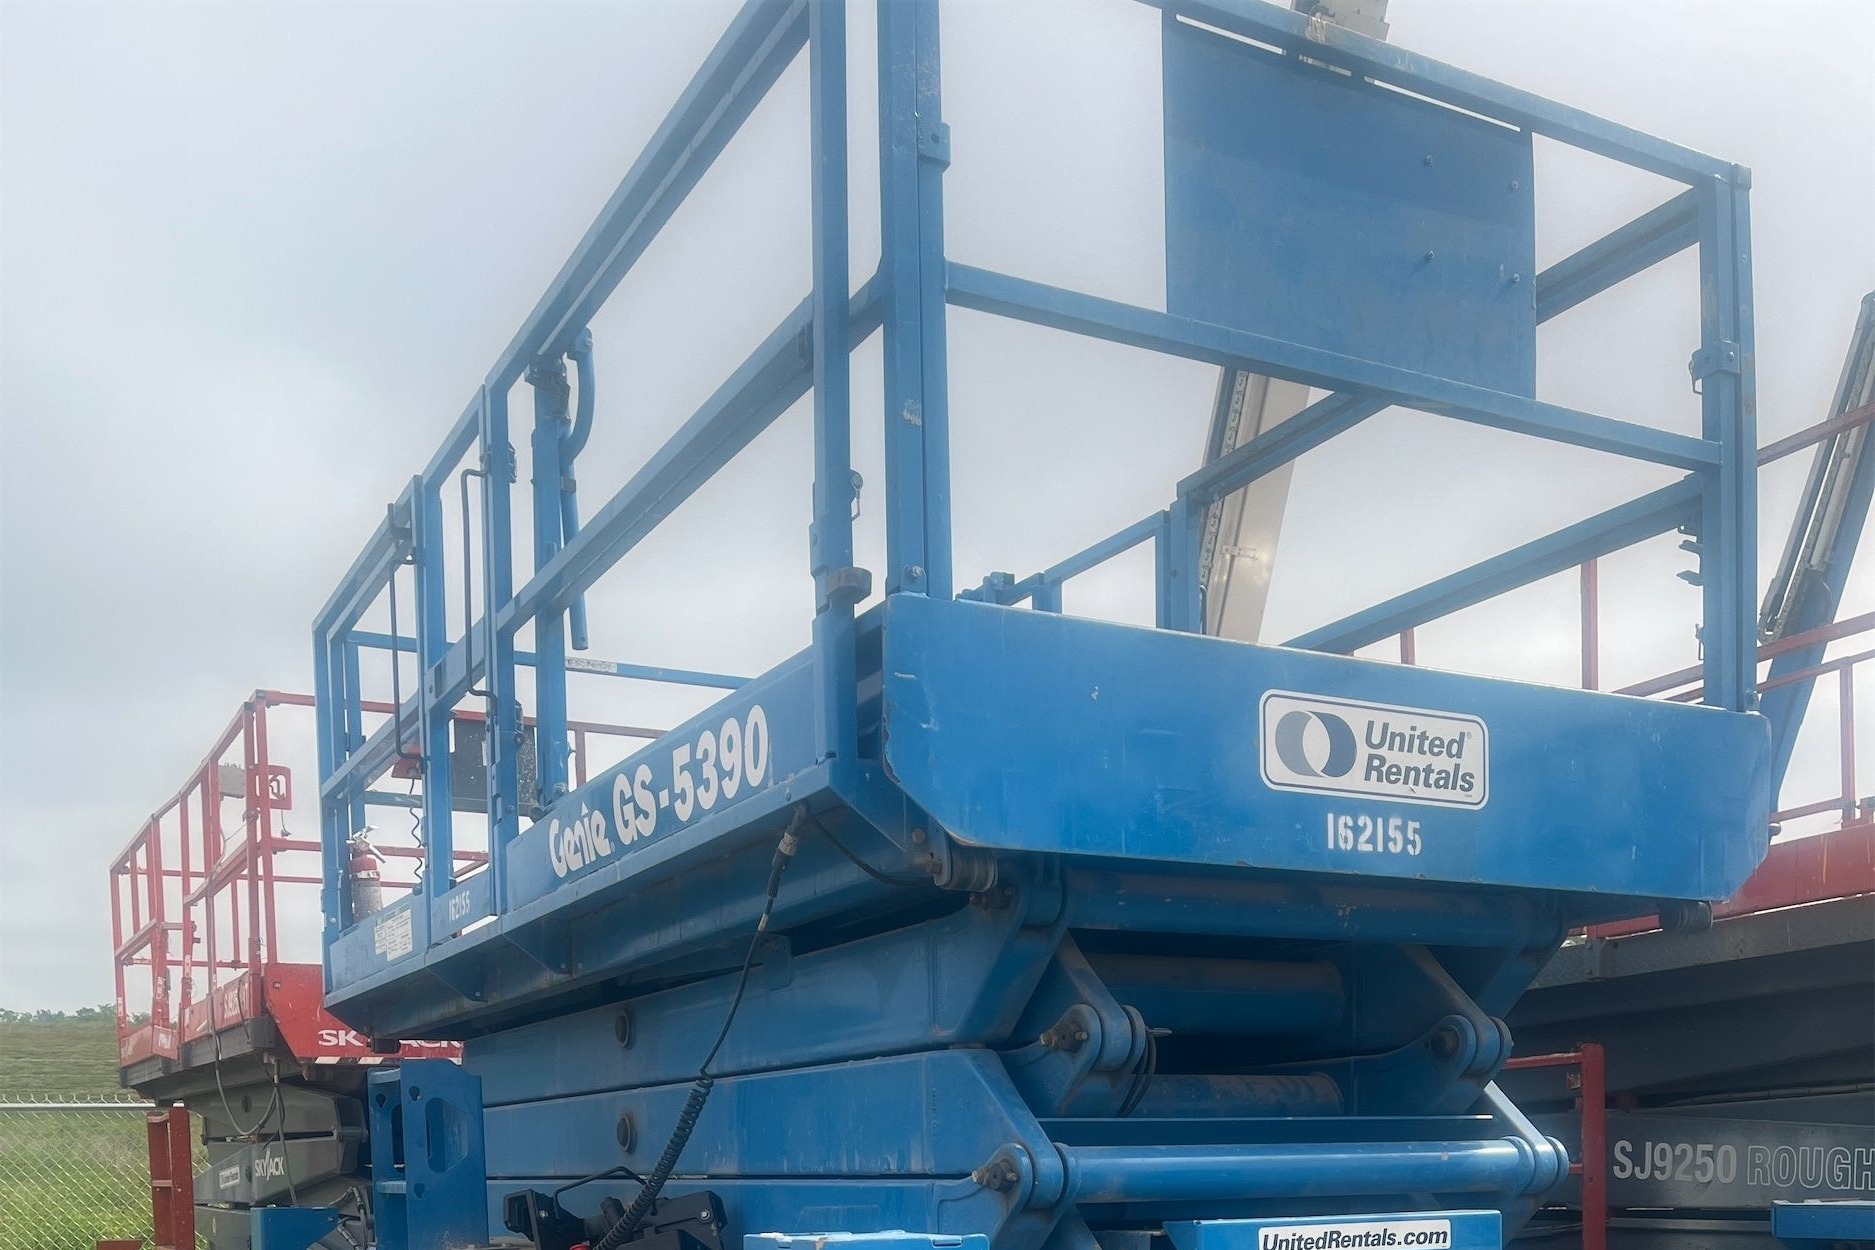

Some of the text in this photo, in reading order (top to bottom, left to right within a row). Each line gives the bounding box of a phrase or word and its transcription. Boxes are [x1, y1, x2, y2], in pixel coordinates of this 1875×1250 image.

[1364, 719, 1466, 759] United
[549, 704, 769, 878] Genie GS-5390
[1363, 753, 1475, 793] Rentals
[1326, 812, 1422, 856] 162155
[1613, 1139, 1875, 1191] SJ9250 ROUGH
